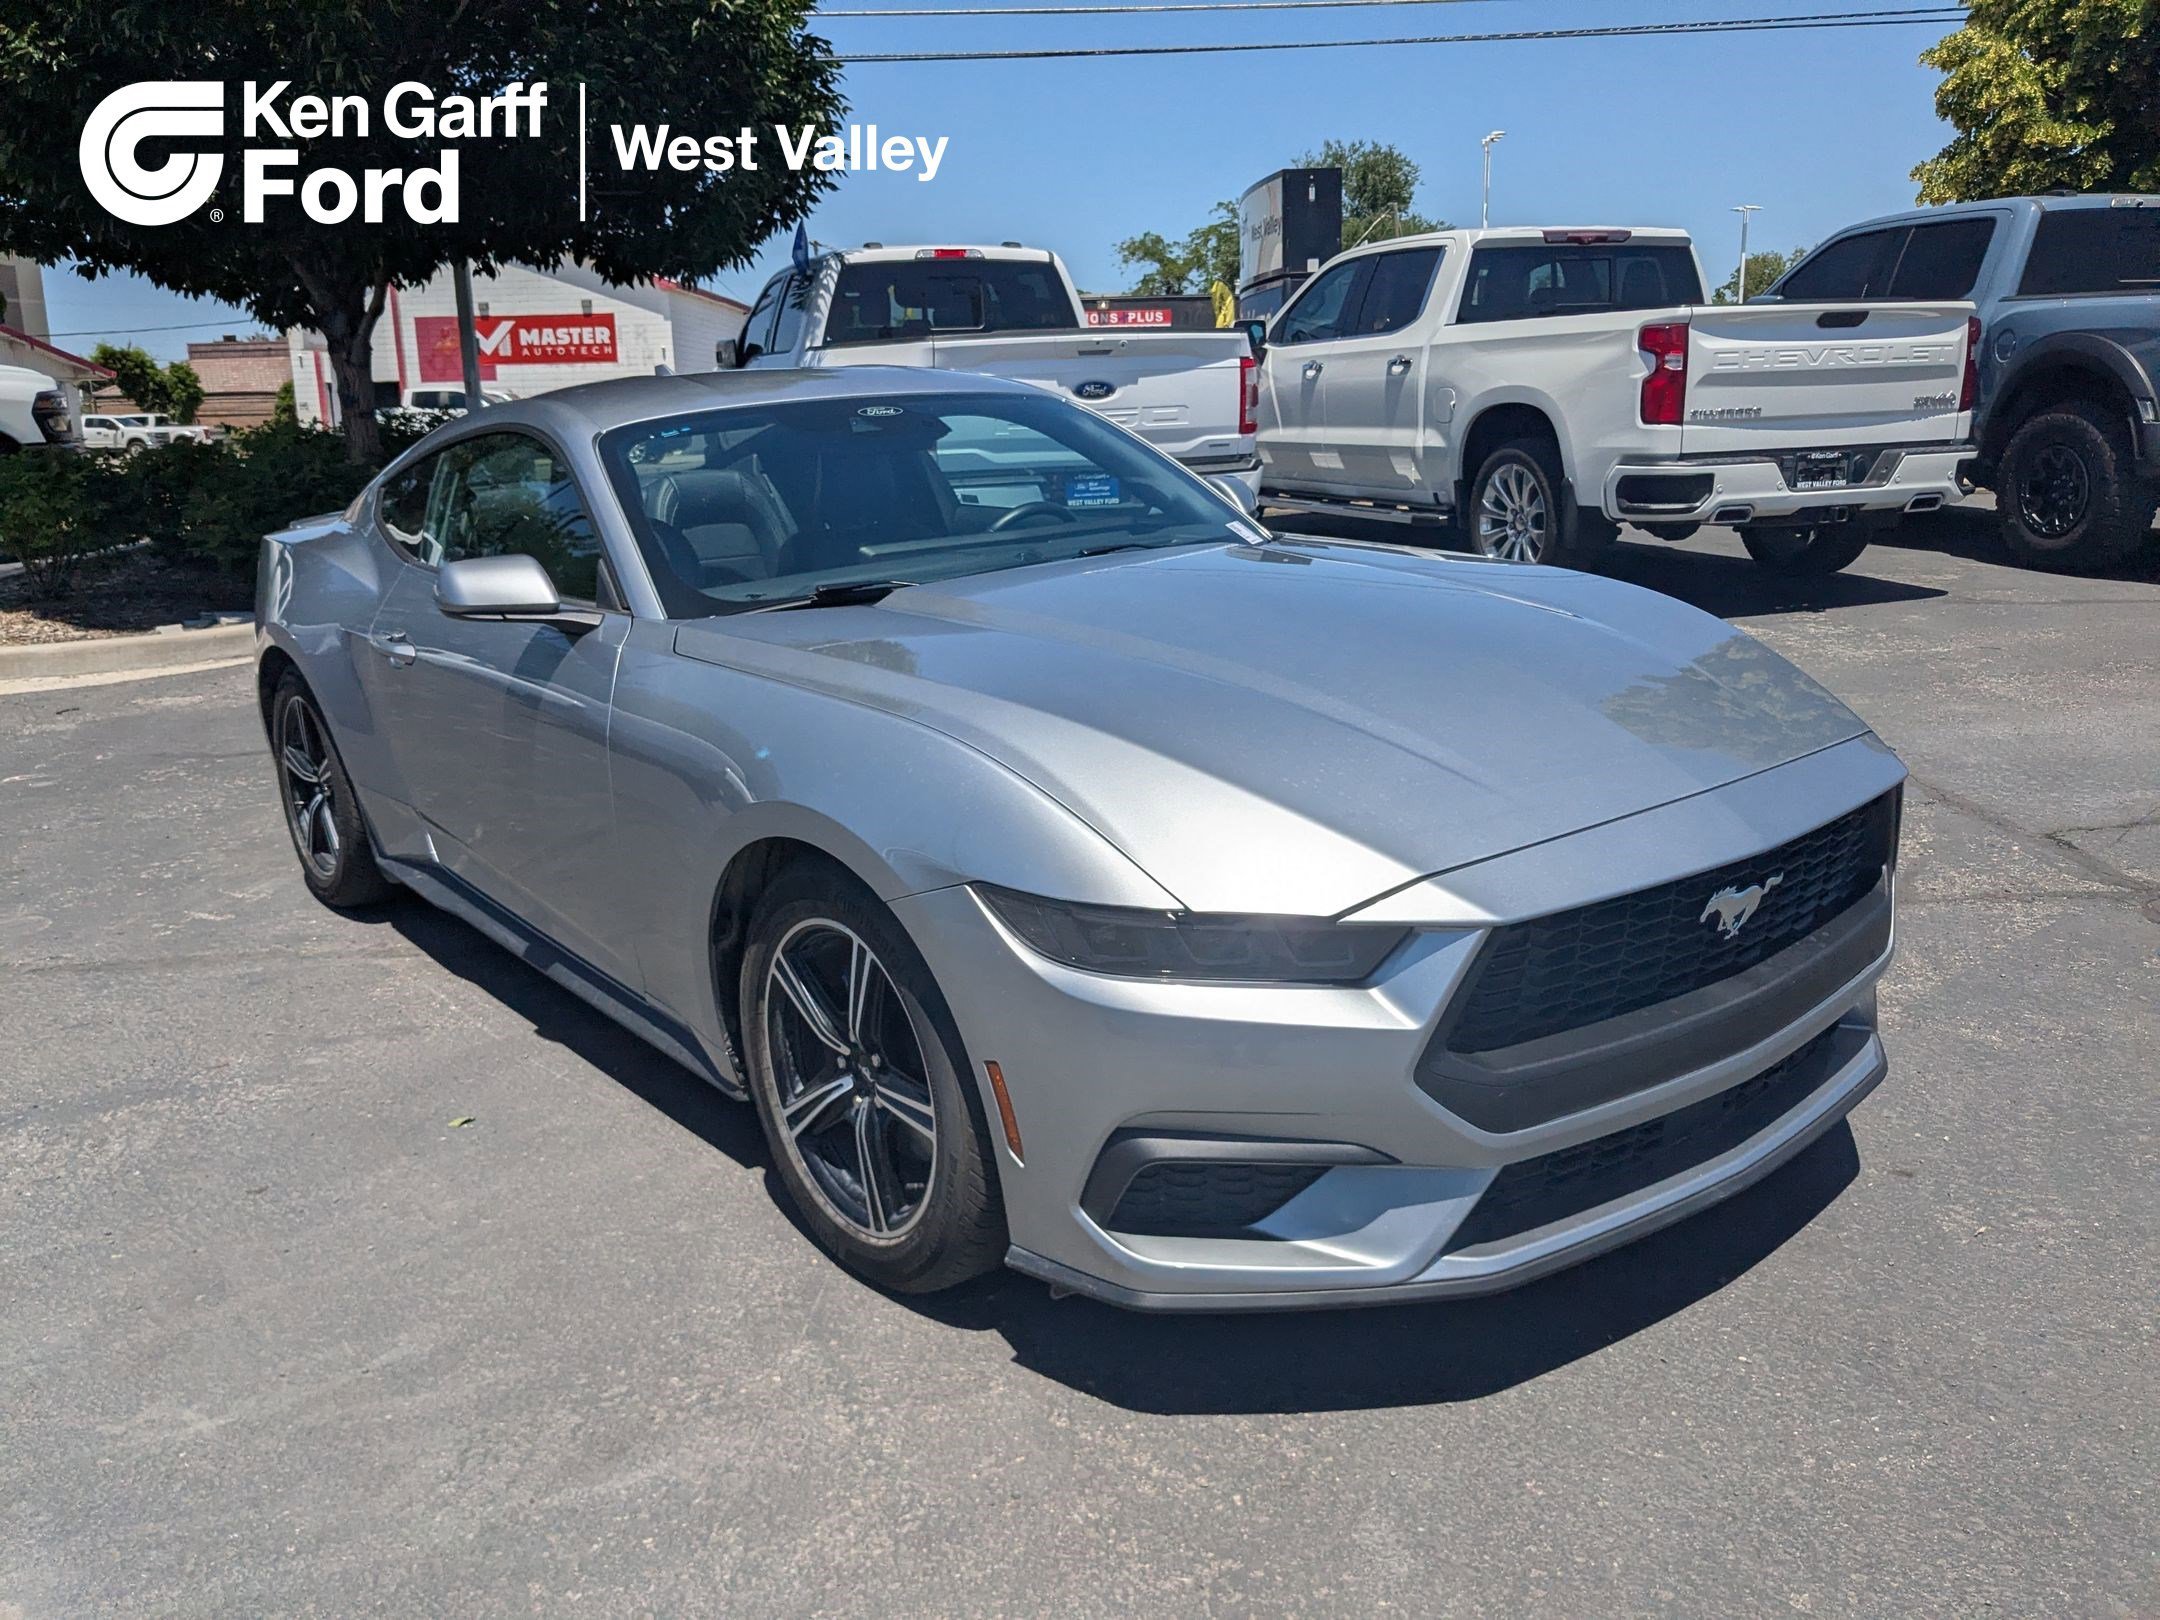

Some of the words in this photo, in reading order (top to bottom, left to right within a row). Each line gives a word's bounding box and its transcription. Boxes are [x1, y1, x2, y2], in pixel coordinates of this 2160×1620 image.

[1127, 311, 1164, 323] PLUS
[519, 326, 611, 346] MASTER
[522, 346, 612, 356] AUTOTECH
[1713, 344, 1954, 370] CHEVROLET
[1082, 383, 1108, 396] Ford
[1084, 498, 1104, 506] VALLEY
